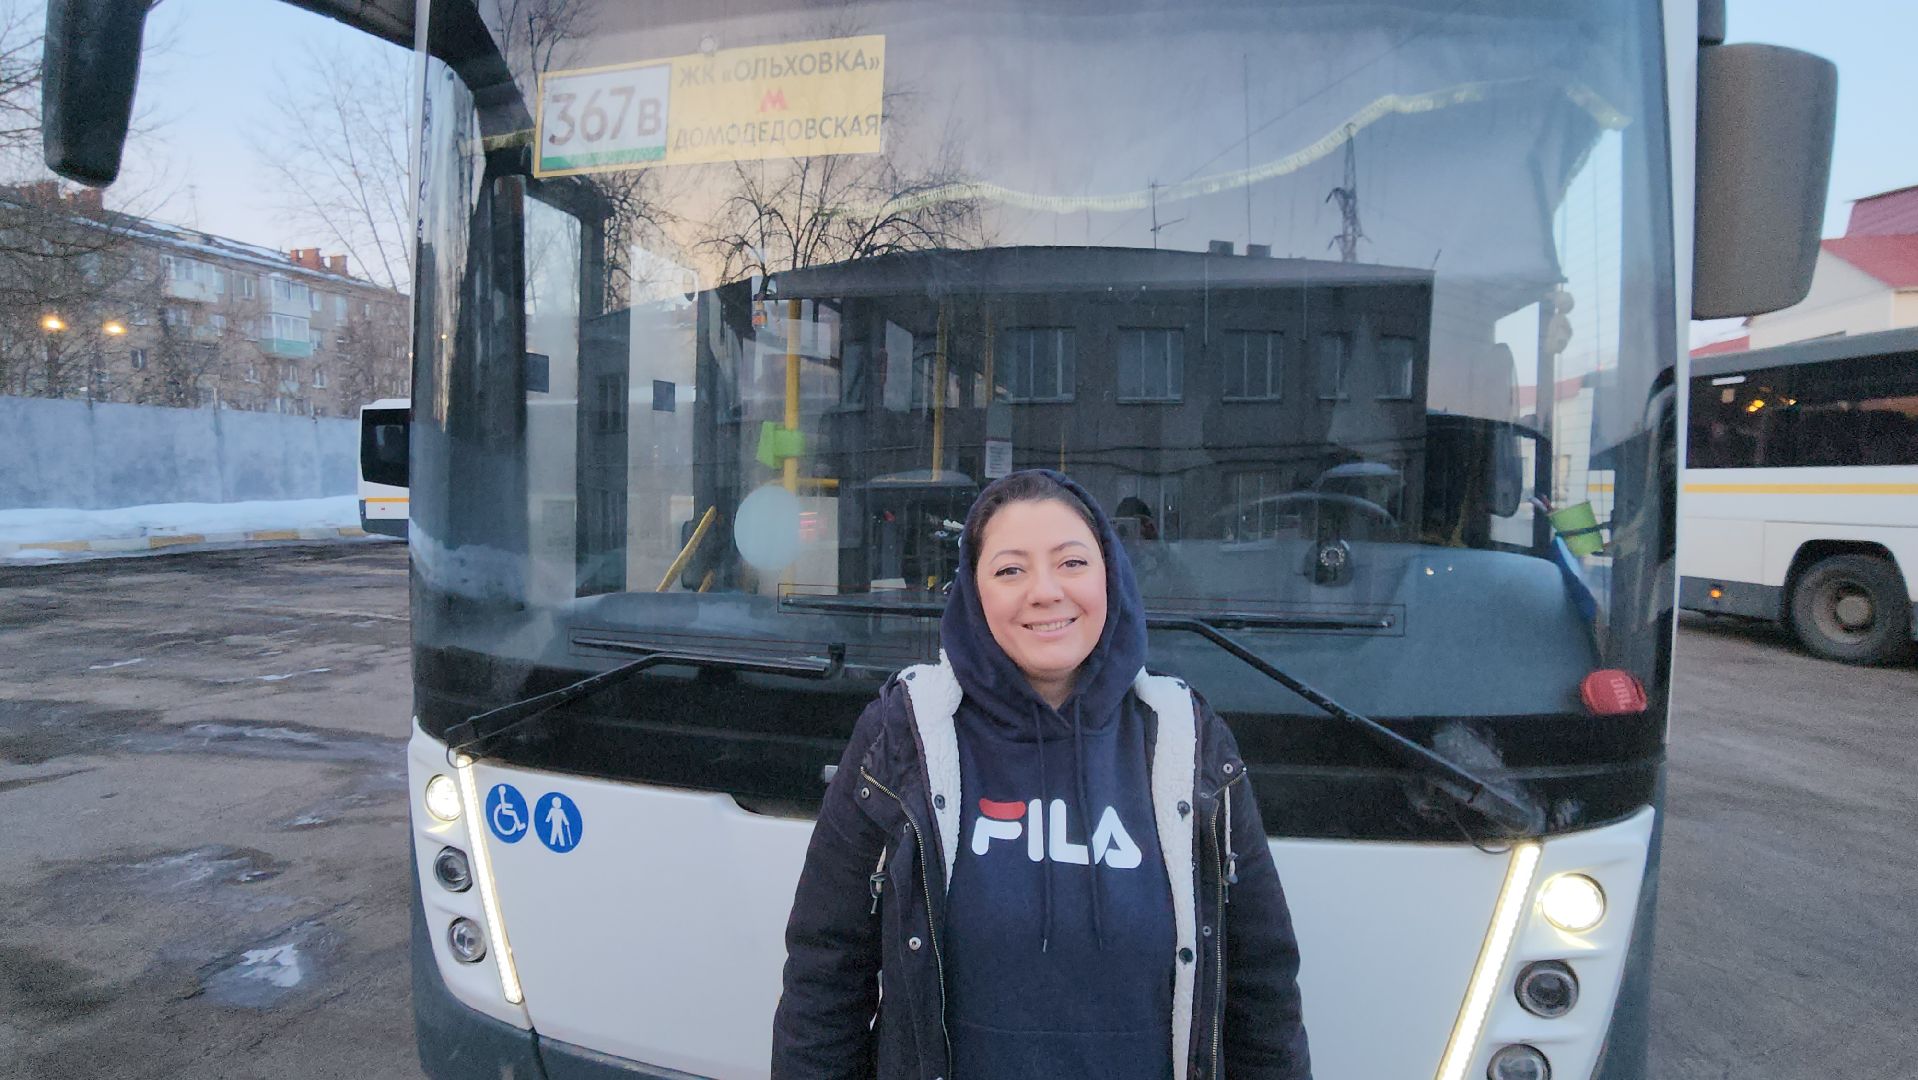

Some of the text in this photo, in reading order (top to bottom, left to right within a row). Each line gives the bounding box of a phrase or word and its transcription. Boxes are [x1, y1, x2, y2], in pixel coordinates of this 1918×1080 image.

[679, 48, 881, 88] ЖК «ОЛЬХОВКА»
[673, 113, 881, 152] ДОМОДЕДОВСКАЯ
[971, 797, 1143, 869] FILA
